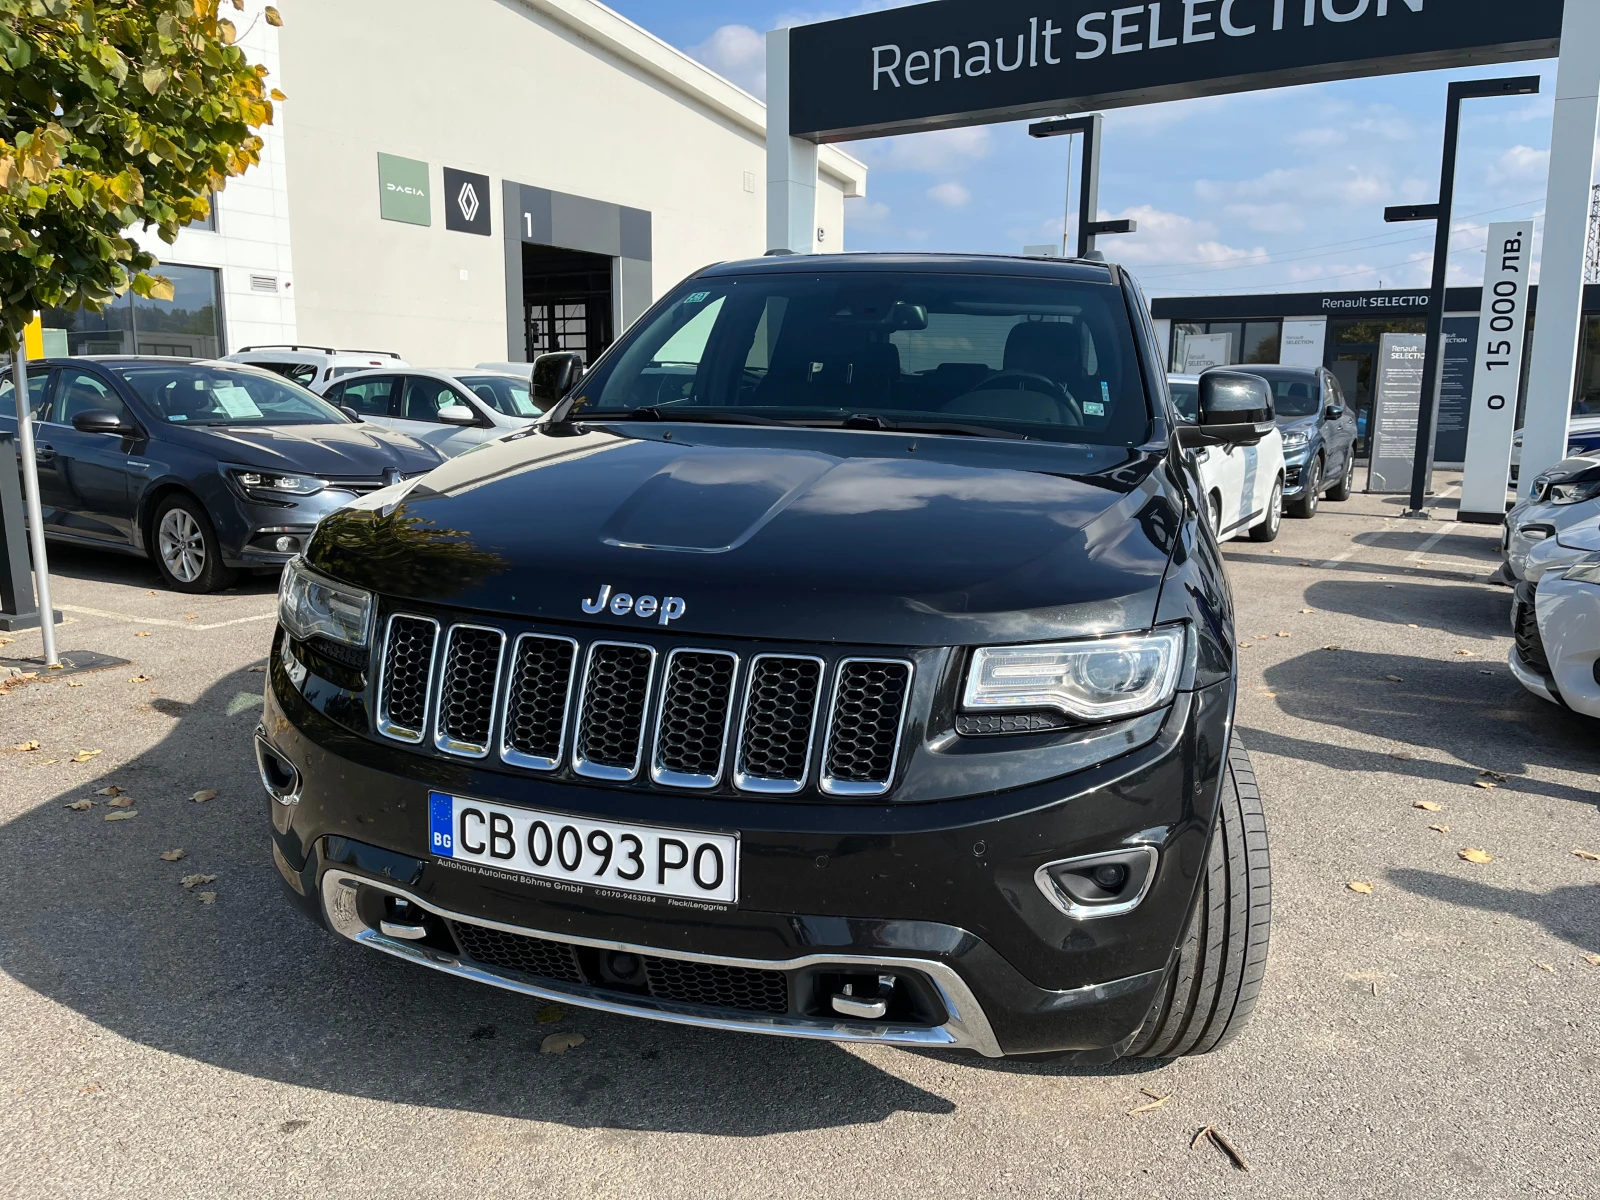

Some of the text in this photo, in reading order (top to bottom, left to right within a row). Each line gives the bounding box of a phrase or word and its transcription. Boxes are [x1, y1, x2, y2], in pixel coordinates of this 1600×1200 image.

[871, 16, 1062, 91] Renault
[386, 183, 425, 197] DACIA
[523, 212, 532, 238] 1
[1322, 295, 1431, 309] Renault SELECTIO
[1490, 280, 1517, 332] 000
[1486, 340, 1511, 371] 15
[581, 584, 686, 626] Jeep
[433, 831, 452, 848] BG
[459, 807, 517, 860] CB
[527, 820, 645, 881] 0093
[437, 858, 584, 894] Autohaus Autoland Böhme GmbH
